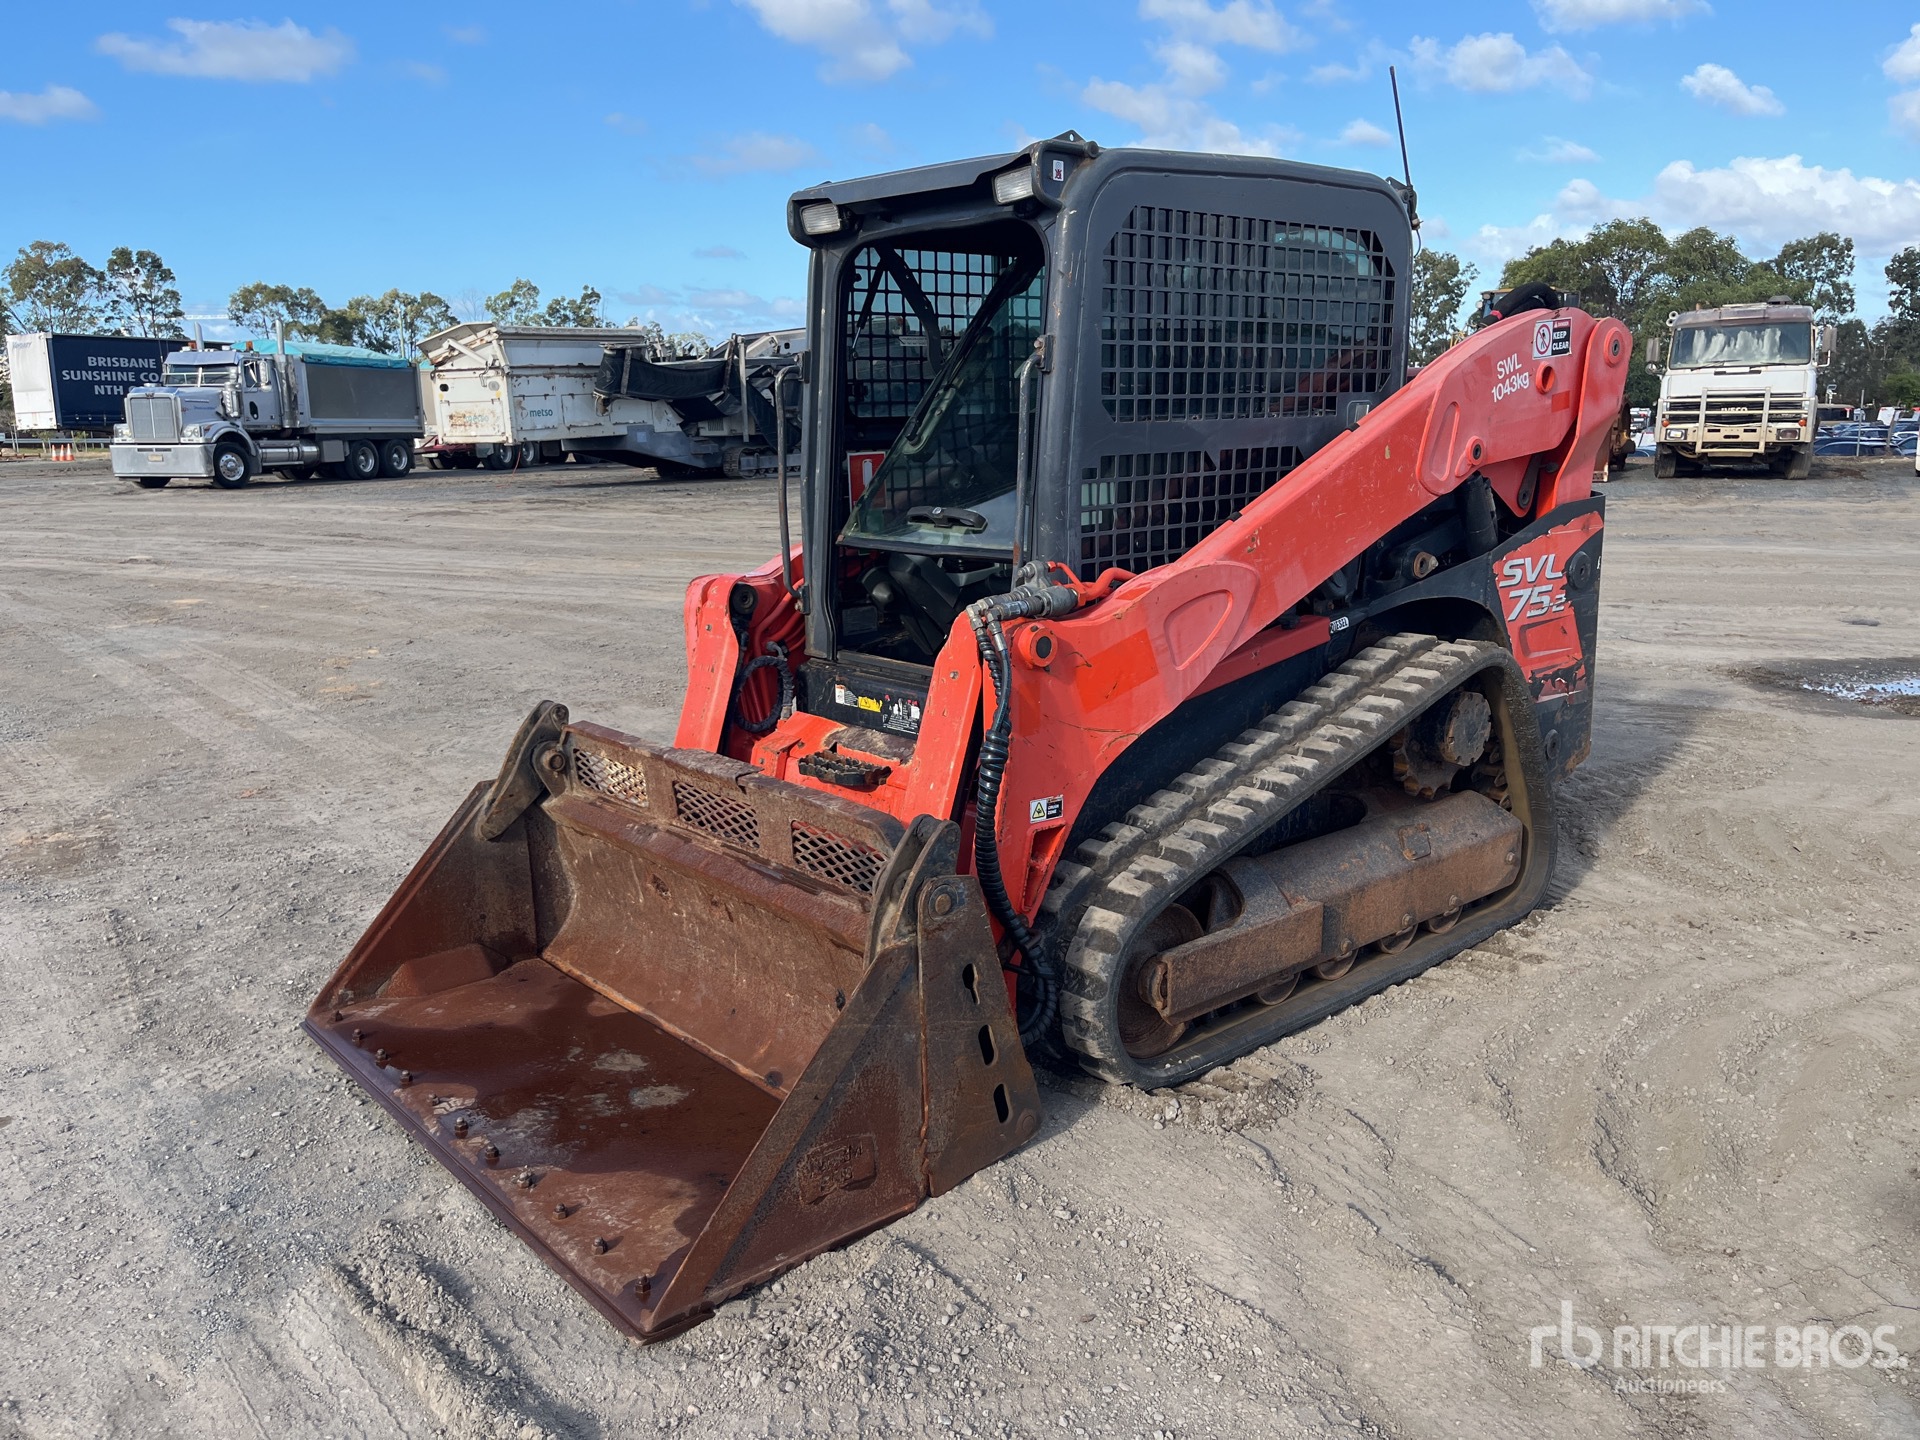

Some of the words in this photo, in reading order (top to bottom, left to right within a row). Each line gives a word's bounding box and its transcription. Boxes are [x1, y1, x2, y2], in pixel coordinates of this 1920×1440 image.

[1553, 330, 1567, 340] KEEP
[1552, 341, 1569, 351] CLEAR
[87, 356, 157, 369] BRISBANE
[1496, 353, 1522, 380] SWL
[61, 369, 136, 382] SUNSHINE
[94, 384, 124, 396] NTH
[1491, 371, 1530, 403] 1043kg
[529, 407, 554, 418] metso
[1499, 553, 1563, 588] SVL
